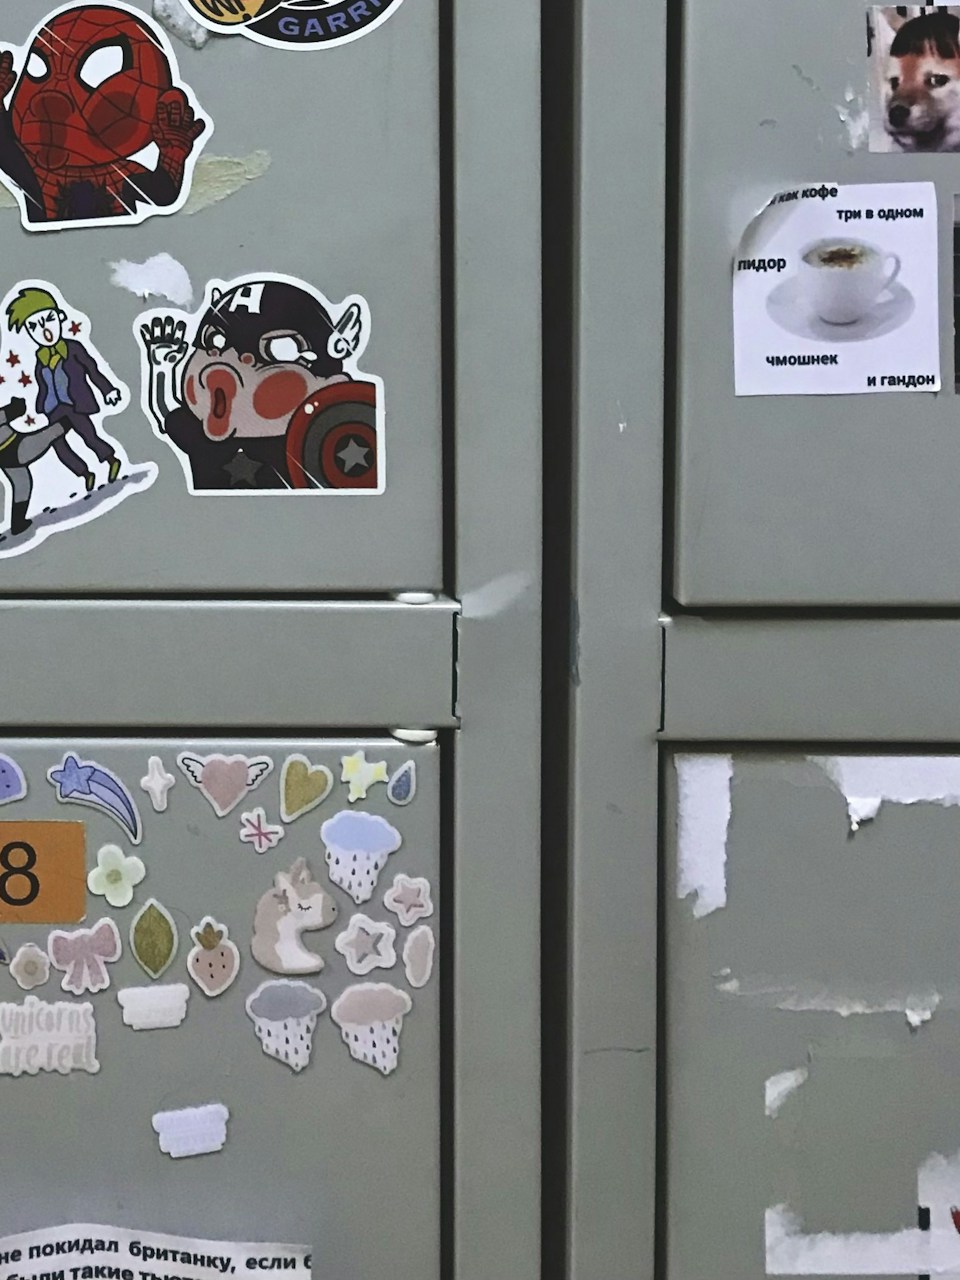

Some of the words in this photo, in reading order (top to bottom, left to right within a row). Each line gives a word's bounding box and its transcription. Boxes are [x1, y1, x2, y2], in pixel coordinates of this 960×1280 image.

[801, 184, 838, 201] кофе
[837, 208, 862, 223] три
[865, 208, 874, 219] в
[878, 207, 924, 221] одном
[738, 257, 787, 273] пидор
[765, 352, 839, 367] чмошнек
[867, 375, 877, 387] и
[880, 373, 935, 389] гандон
[28, 1238, 119, 1260] покидал
[128, 1240, 237, 1274] британку,
[245, 1255, 297, 1270] если
